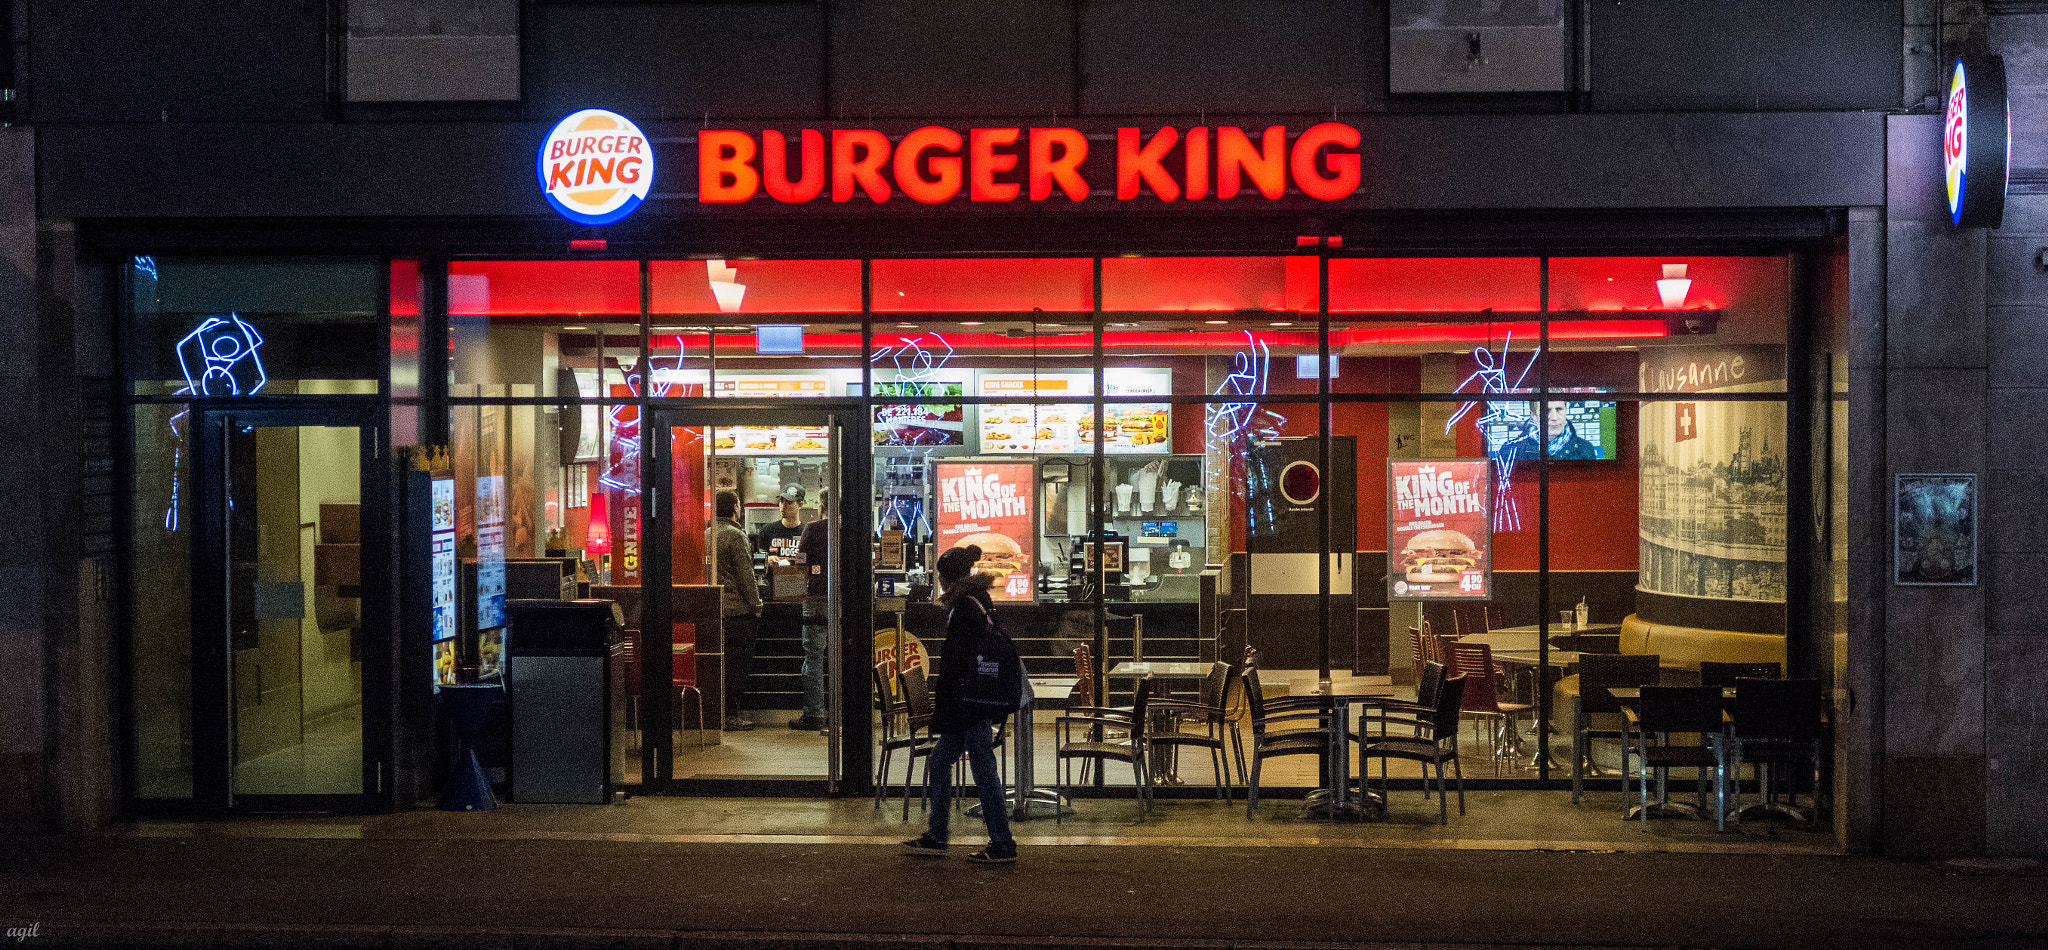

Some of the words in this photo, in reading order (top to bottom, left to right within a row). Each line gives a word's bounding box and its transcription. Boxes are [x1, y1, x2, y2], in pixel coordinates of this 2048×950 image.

[550, 135, 642, 160] BURGER
[1945, 116, 1962, 166] NG
[549, 156, 642, 190] KING
[699, 125, 1089, 204] BURGER
[1117, 122, 1361, 202] KING
[1651, 355, 1745, 393] Lausanne
[941, 473, 1001, 503] KING
[1001, 484, 1017, 498] OF
[1395, 471, 1454, 500] KING
[1454, 481, 1470, 495] OF
[943, 502, 960, 513] THE
[960, 496, 1026, 520] MONTH
[1397, 500, 1414, 510] THE
[1414, 493, 1480, 517] MONTH
[624, 506, 638, 578] IGNITE
[780, 547, 800, 556] DOGS
